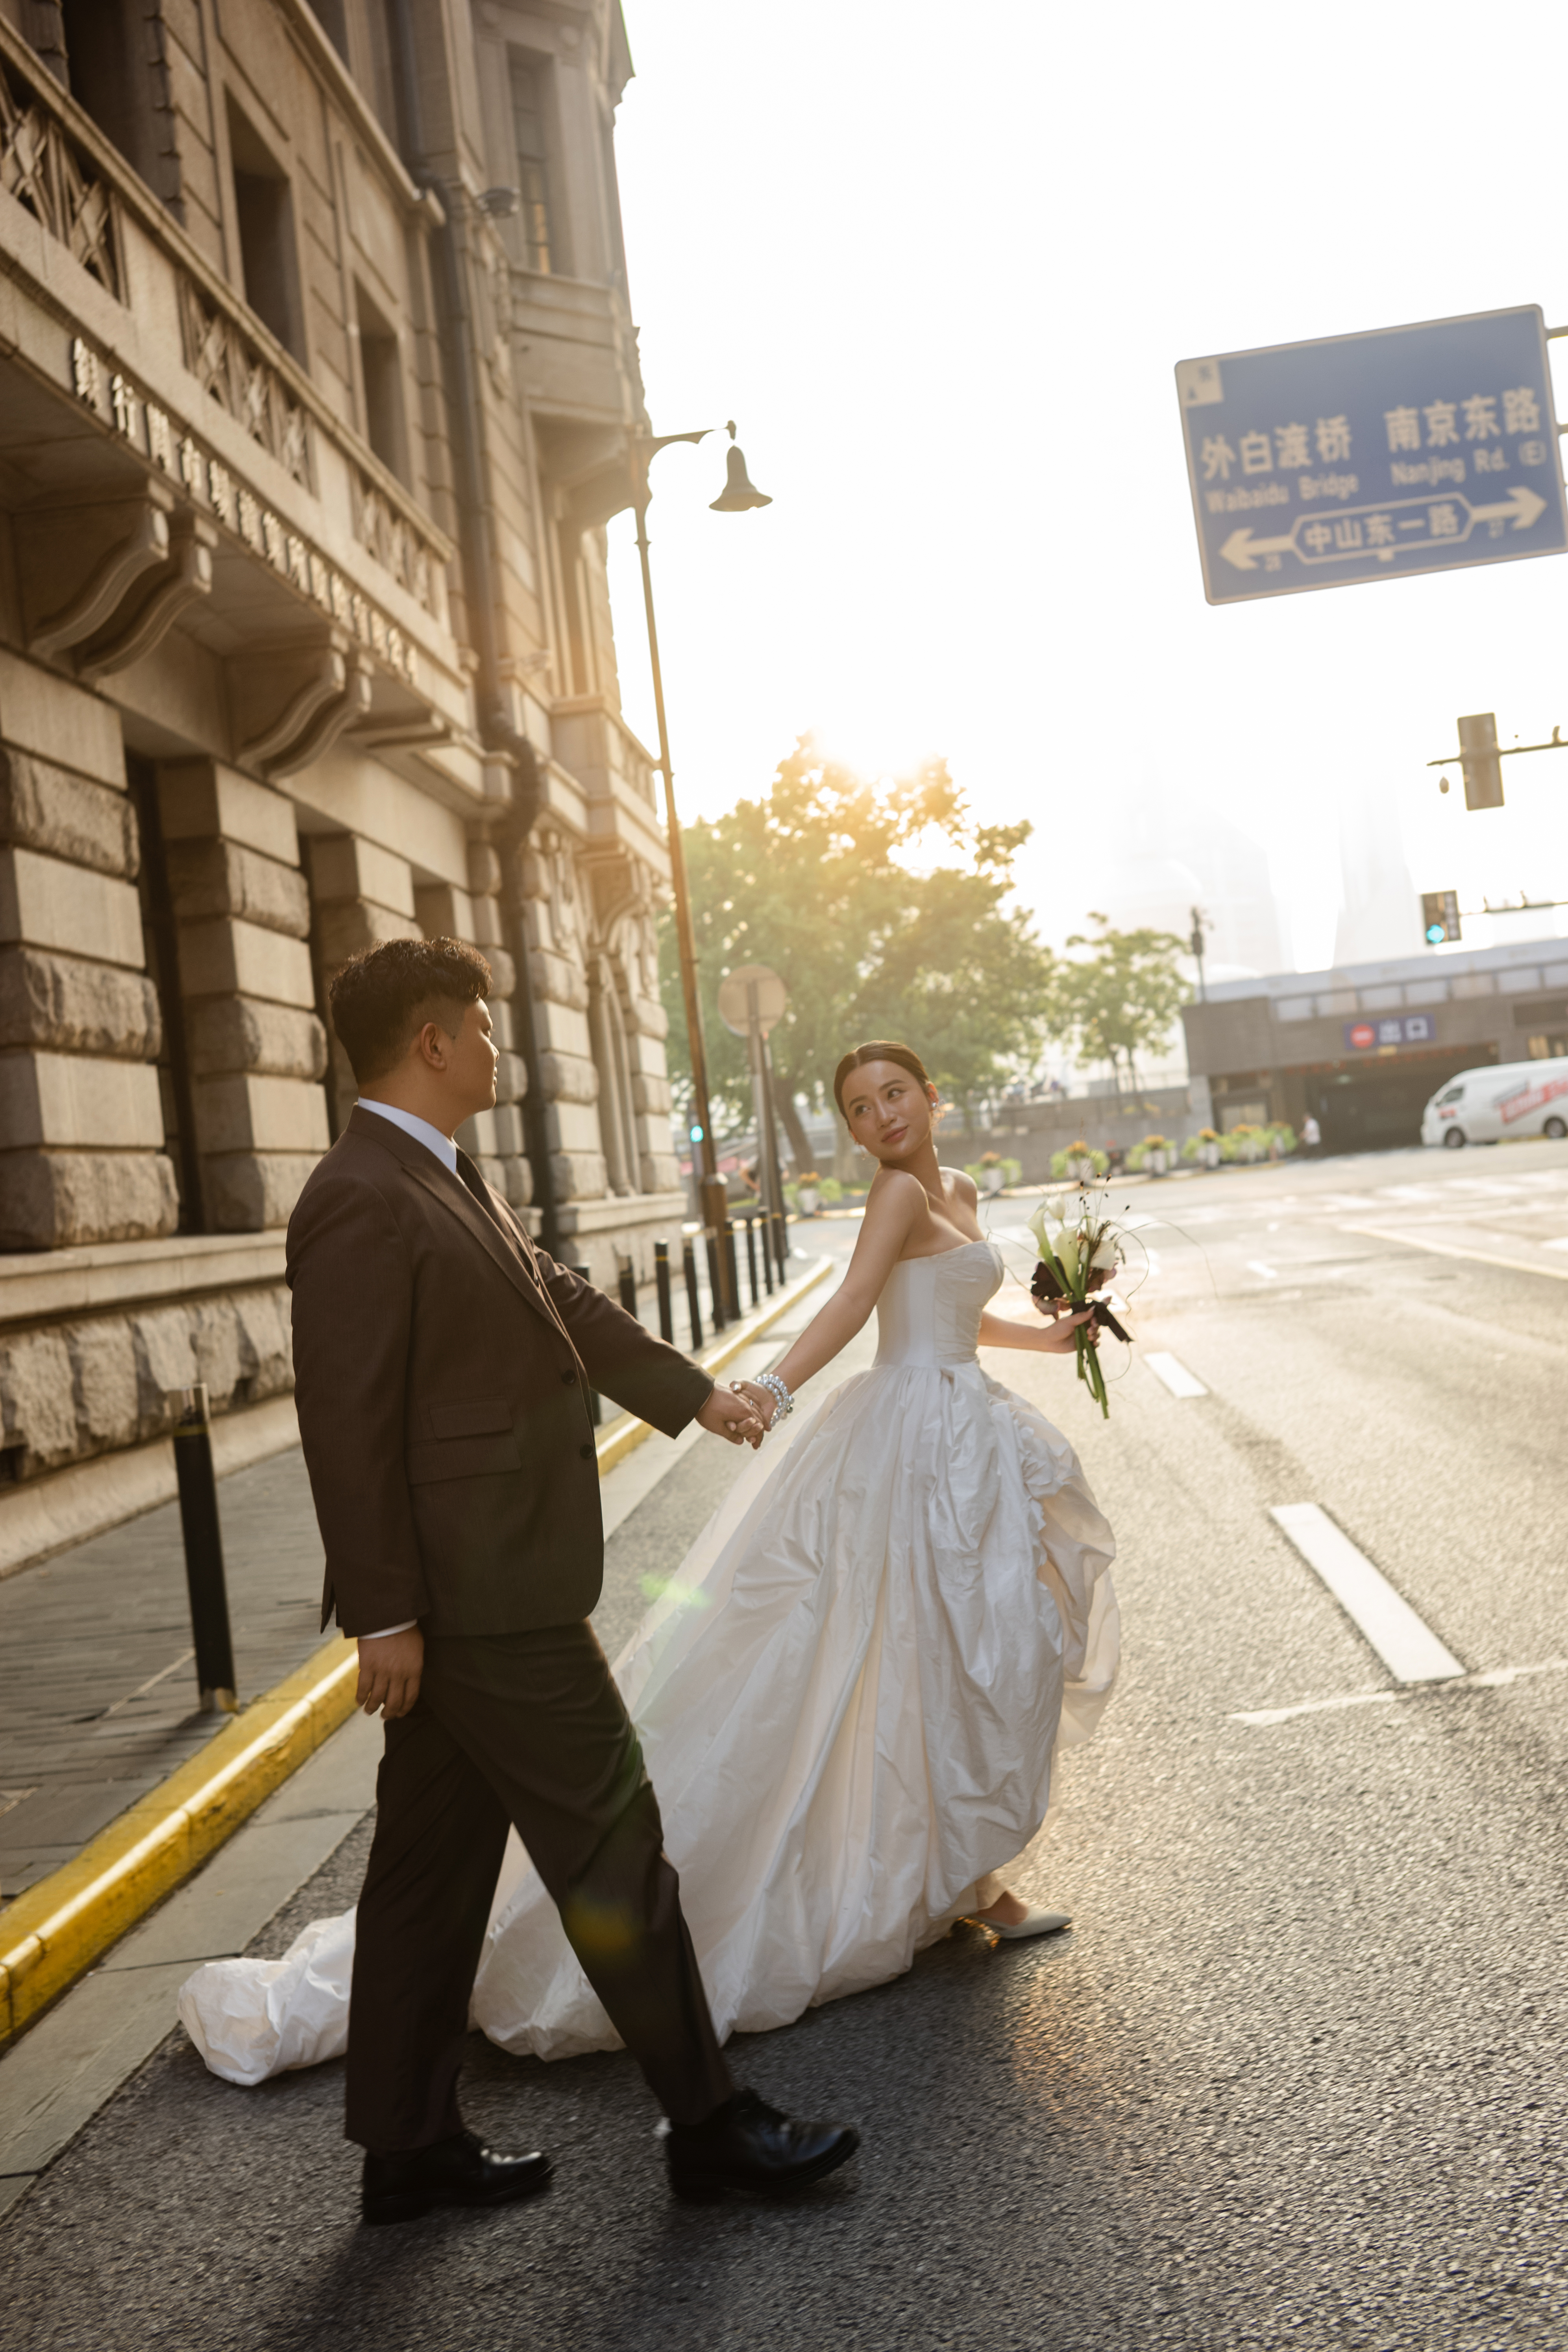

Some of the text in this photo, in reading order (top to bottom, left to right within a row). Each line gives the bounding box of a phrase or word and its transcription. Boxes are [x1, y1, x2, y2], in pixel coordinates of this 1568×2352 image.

[1383, 386, 1541, 453] 南京东路
[1200, 415, 1352, 480] 外白渡桥
[1389, 456, 1466, 486] Nanjing
[1299, 472, 1359, 501] Bridge
[1304, 503, 1459, 554] 中山东一路
